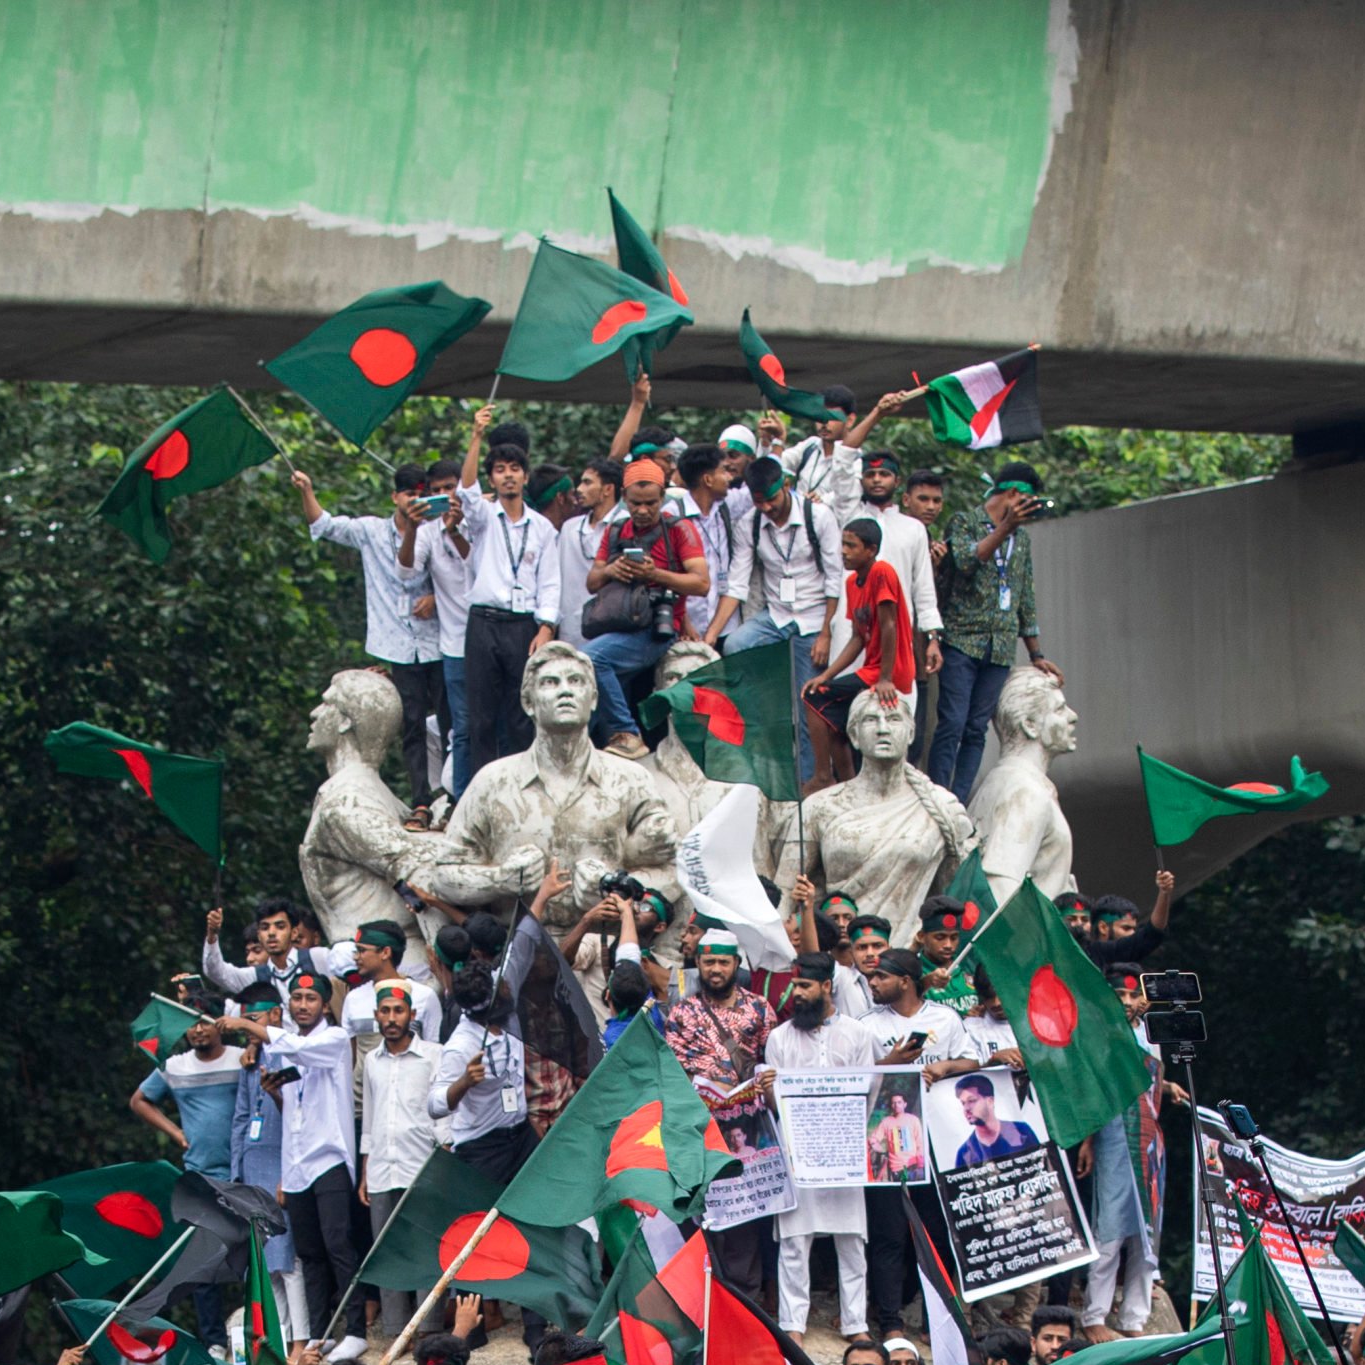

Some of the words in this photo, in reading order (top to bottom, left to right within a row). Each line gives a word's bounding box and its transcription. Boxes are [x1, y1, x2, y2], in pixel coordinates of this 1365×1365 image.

[965, 1238, 990, 1256] পুলিশ
[965, 1269, 987, 1283] এবং
[1005, 1253, 1039, 1272] হাসিনার
